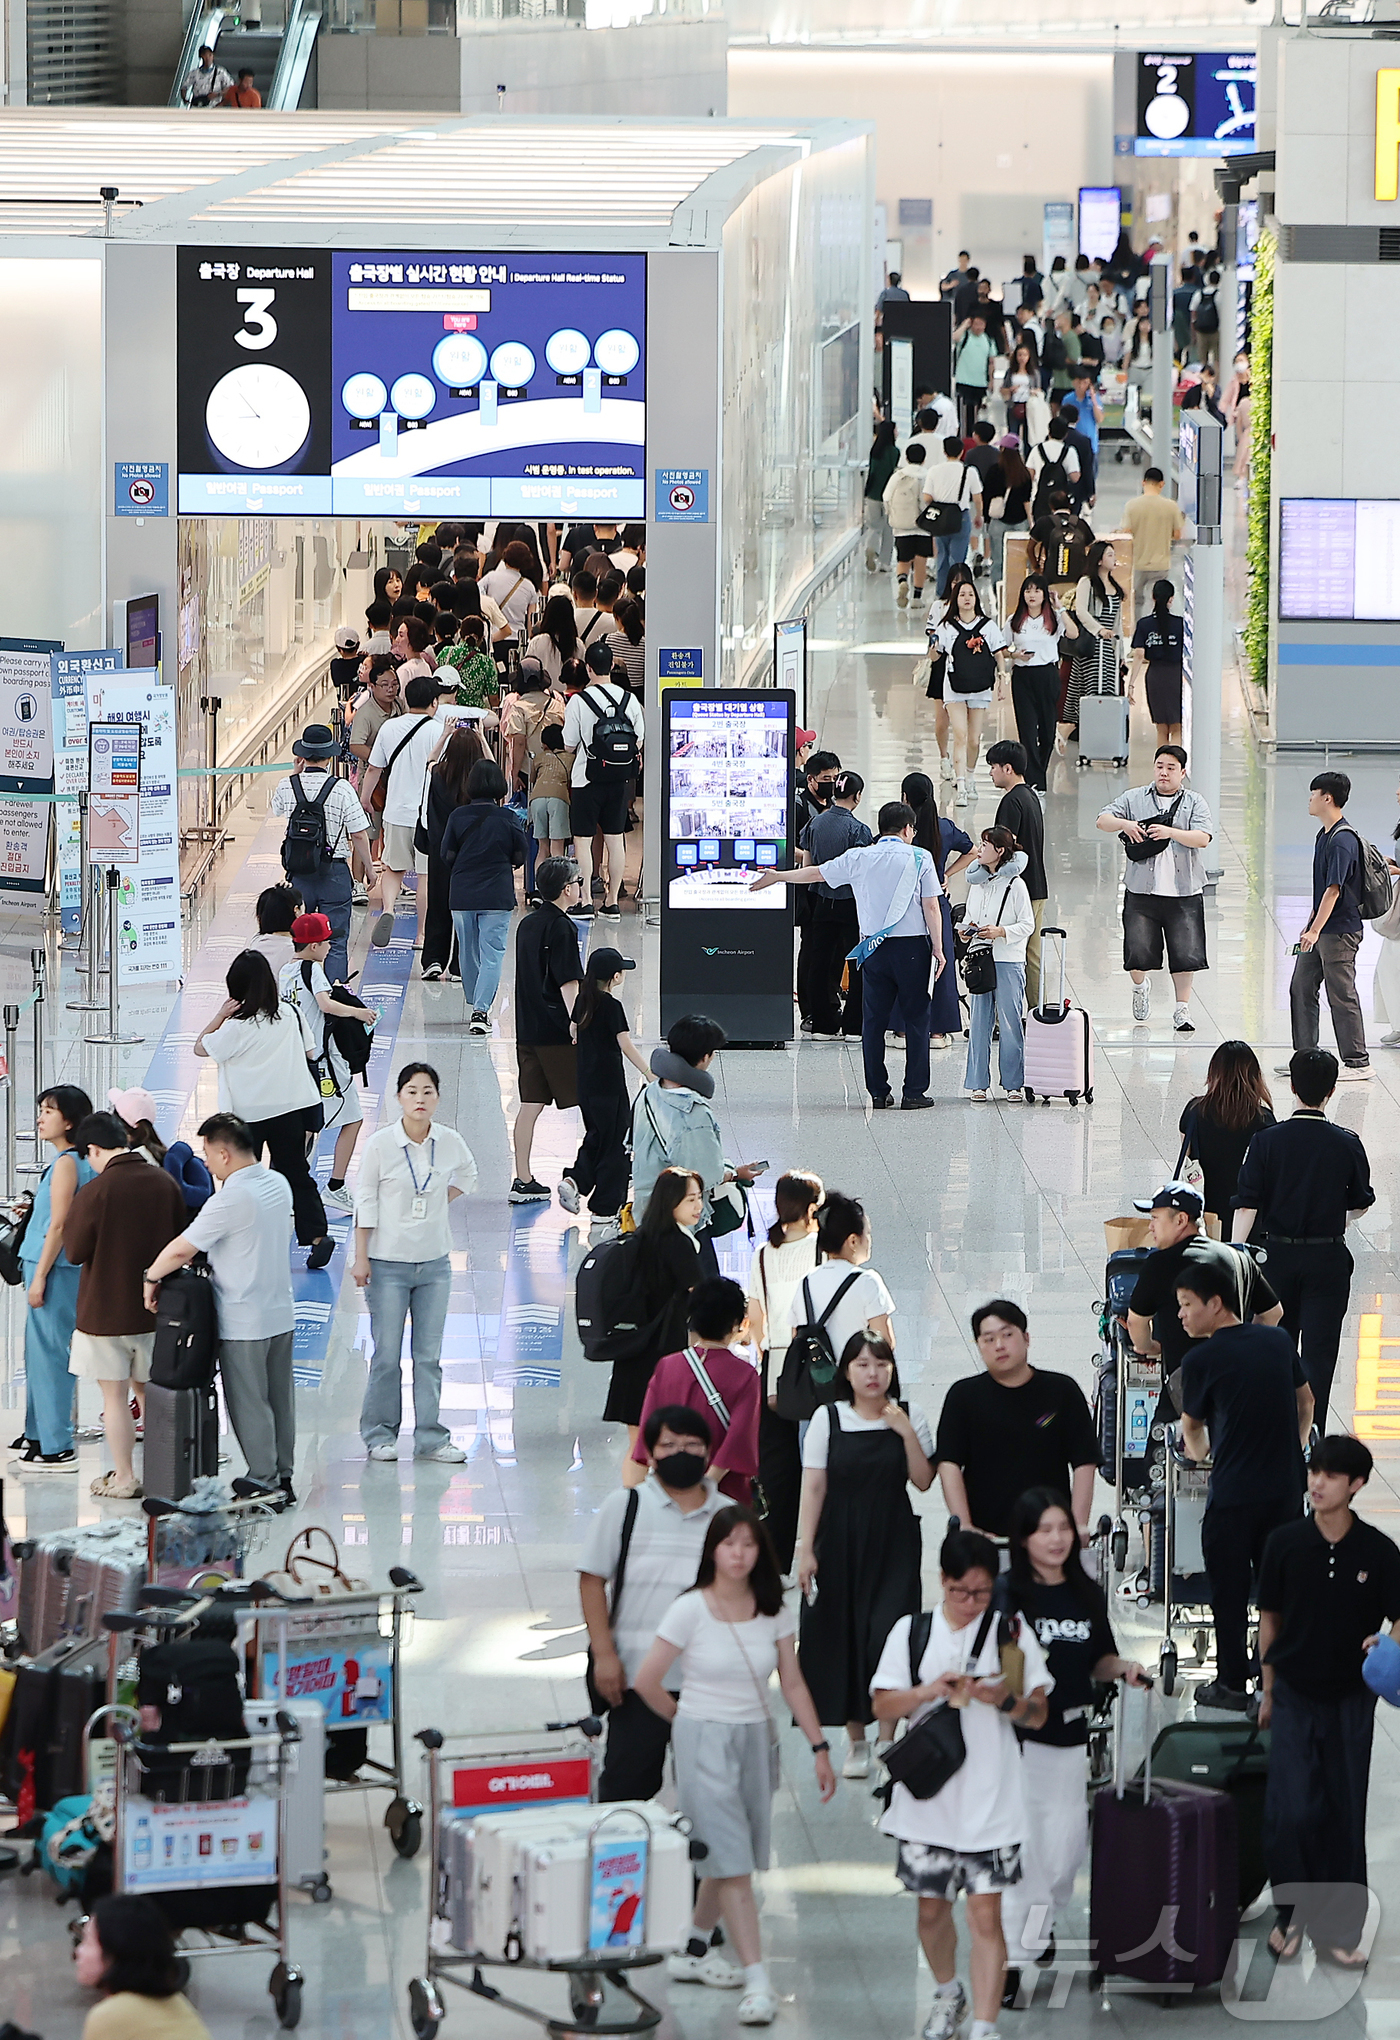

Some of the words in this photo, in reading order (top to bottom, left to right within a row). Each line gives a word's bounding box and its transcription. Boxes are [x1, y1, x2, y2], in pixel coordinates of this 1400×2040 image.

[1156, 65, 1178, 94] 2
[199, 262, 240, 280] 출국장
[246, 267, 295, 280] Departure
[297, 267, 314, 279] Hall
[349, 264, 404, 283] 출국장별
[406, 264, 448, 283] 실시간
[449, 265, 477, 283] 현황
[479, 265, 507, 283] 안내
[514, 273, 550, 284] Departure
[551, 273, 565, 283] Hall
[566, 273, 600, 283] Real-time
[601, 274, 626, 284] Status
[234, 287, 278, 350] 3
[588, 377, 596, 388] 2
[484, 389, 493, 400] 3
[383, 421, 393, 433] 4
[524, 465, 540, 475] 시범
[578, 467, 593, 475] test
[662, 471, 702, 480] 사진촬영금지
[206, 482, 248, 495] 일반여권
[252, 483, 304, 496] Passport
[363, 484, 405, 497] 일반여권
[409, 485, 461, 498] Passport
[521, 485, 562, 498] 일반여권
[567, 486, 618, 499] Passport
[671, 651, 691, 660] 환송객
[23, 658, 43, 669] carry
[57, 657, 115, 674] 외국환신고
[668, 661, 694, 669] 진입불가
[13, 668, 44, 678] passport
[3, 676, 33, 688] boarding
[34, 681, 51, 689] pass
[693, 702, 723, 713] 출국장별
[724, 702, 748, 713] 대기열
[749, 702, 765, 713] 상황
[107, 712, 124, 722] 해외
[126, 710, 150, 722] 여행시
[712, 721, 723, 729] 2번
[726, 721, 746, 729] 출국장
[2, 727, 46, 739] 여권/탑승권은
[12, 739, 33, 748] 반드시
[4, 749, 25, 759] 본인이
[26, 750, 40, 760] 소지
[8, 760, 35, 771] 해주세요
[712, 760, 723, 768] 4번
[726, 760, 746, 768] 출국장
[712, 800, 723, 808] 5번
[726, 800, 746, 808] 출국장
[4, 819, 16, 827] not
[17, 820, 43, 829] allowed
[3, 828, 10, 836] to
[5, 841, 28, 851] 환송객
[7, 852, 22, 862] 절대
[0, 862, 30, 873] 진입금지
